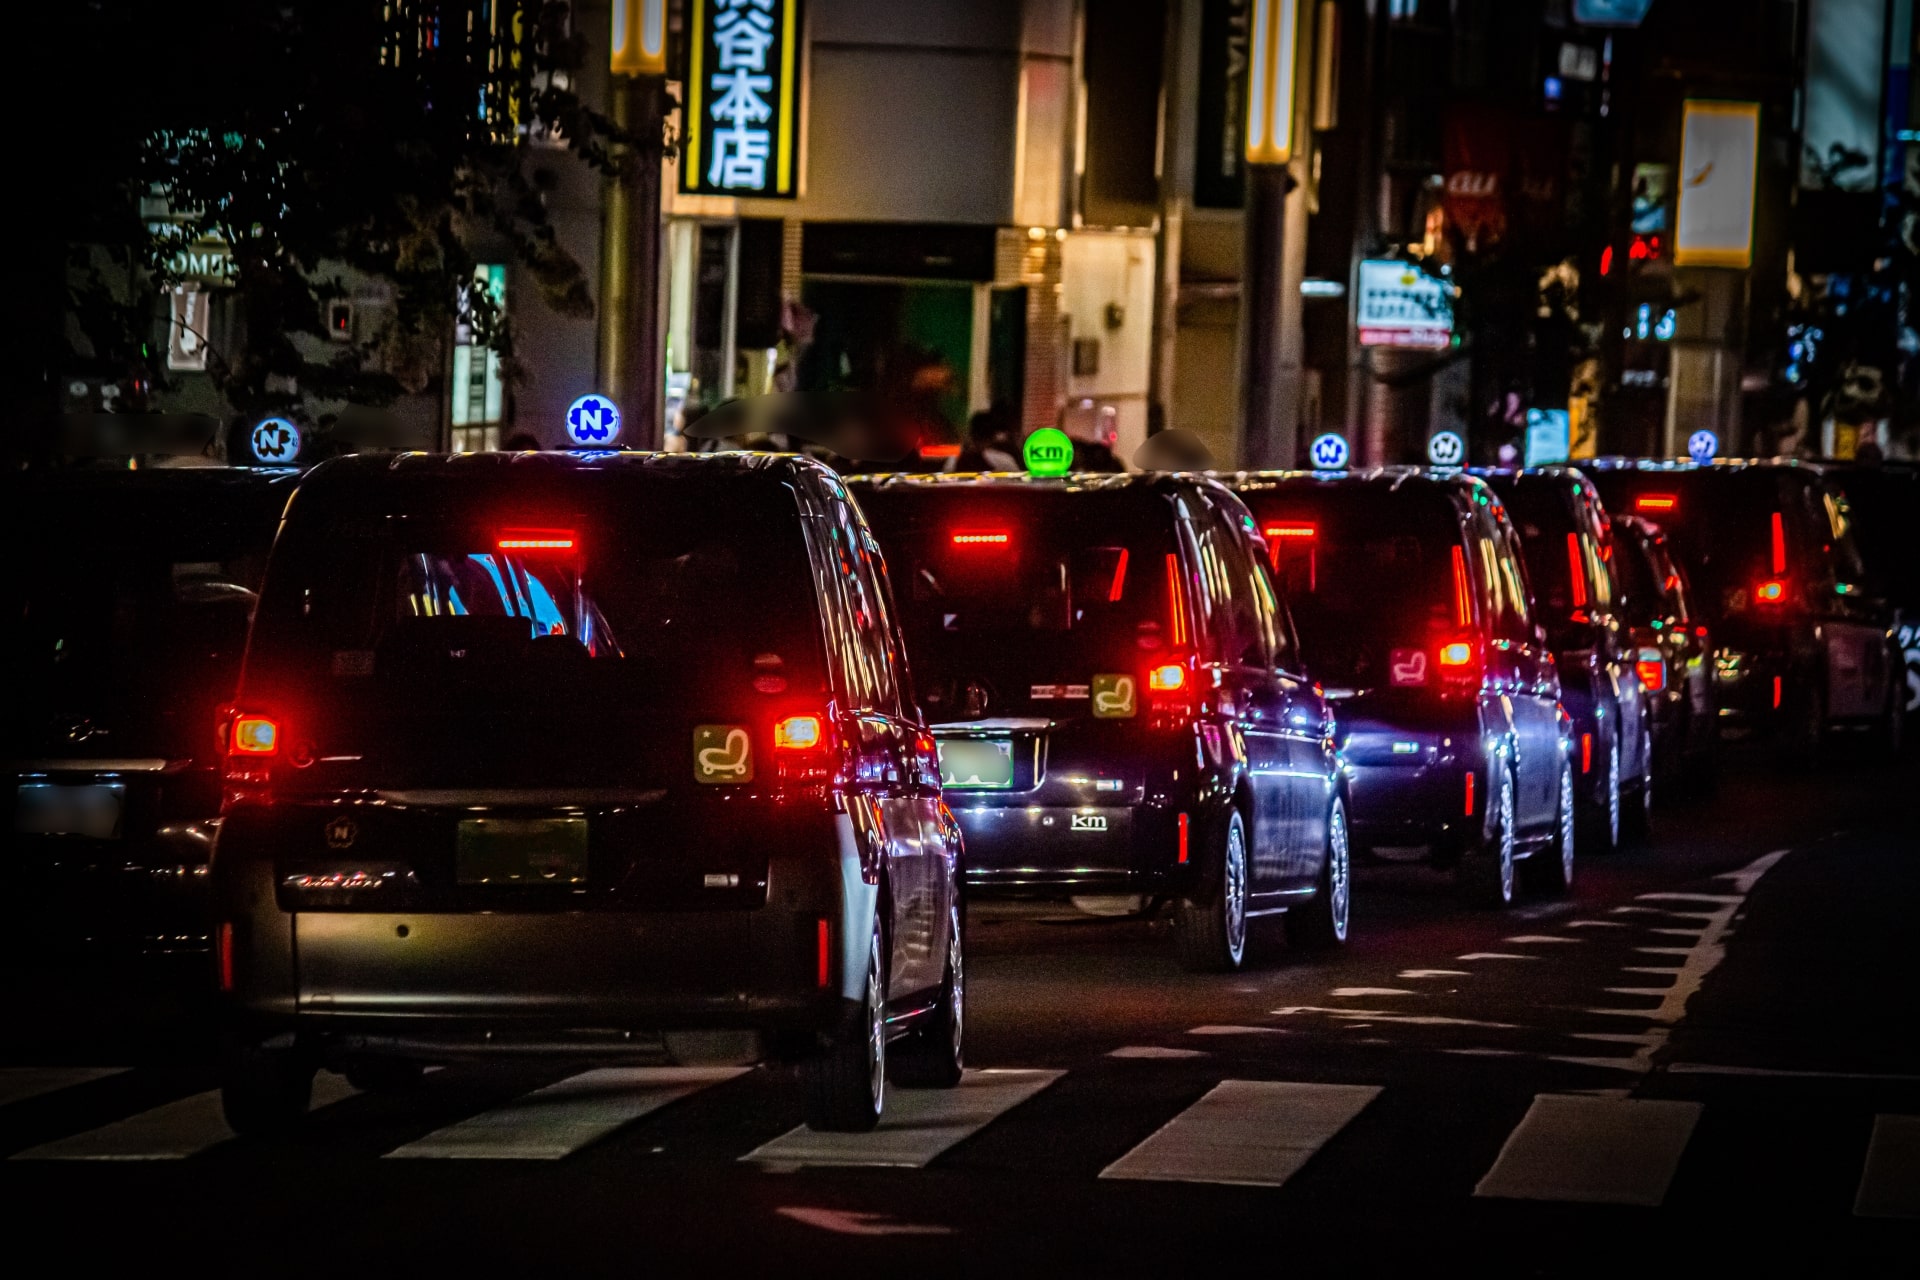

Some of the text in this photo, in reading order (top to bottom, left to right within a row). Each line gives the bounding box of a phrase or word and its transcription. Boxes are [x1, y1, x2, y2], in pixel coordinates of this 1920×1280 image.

[707, 0, 775, 190] 谷本店
[1447, 170, 1497, 198] au
[580, 409, 602, 431] N
[260, 429, 279, 449] N
[1030, 446, 1064, 459] km
[1071, 814, 1107, 830] km
